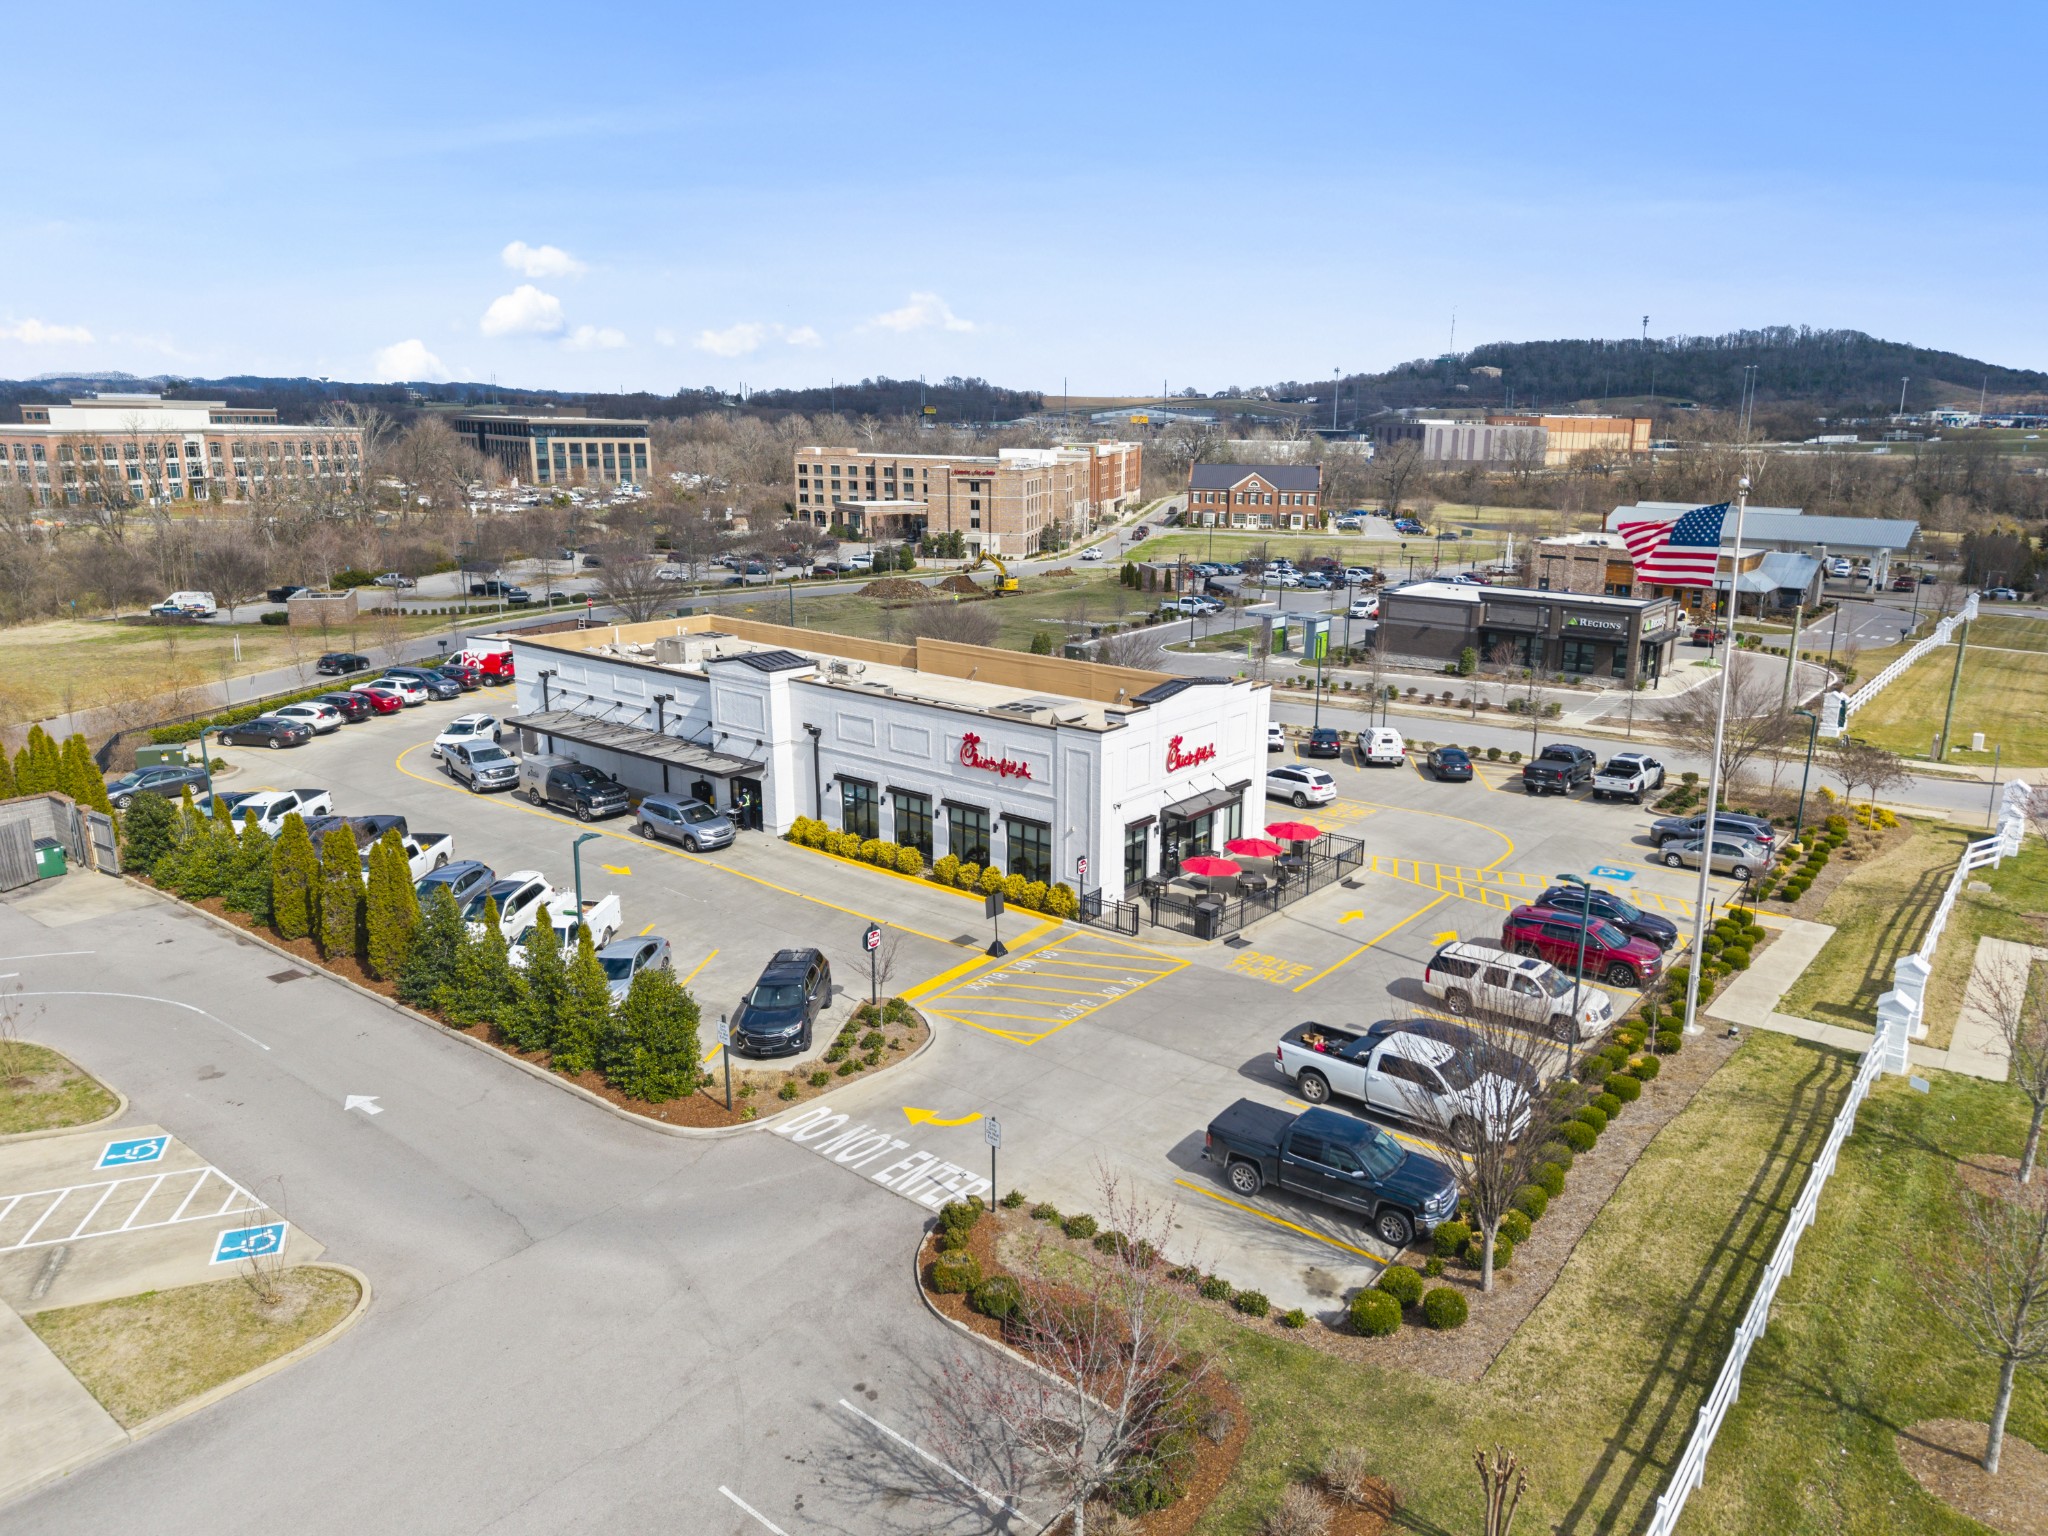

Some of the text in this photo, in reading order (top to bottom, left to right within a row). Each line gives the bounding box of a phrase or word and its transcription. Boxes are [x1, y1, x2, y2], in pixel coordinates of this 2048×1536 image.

[1580, 618, 1621, 629] REGIONS
[960, 732, 1032, 779] Chick-fil-A
[1166, 735, 1216, 773] Chick-fil-A
[964, 972, 1010, 991] BLOCK
[1056, 999, 1098, 1020] BLOCK
[774, 1106, 992, 1208] DO NOT ENTER
